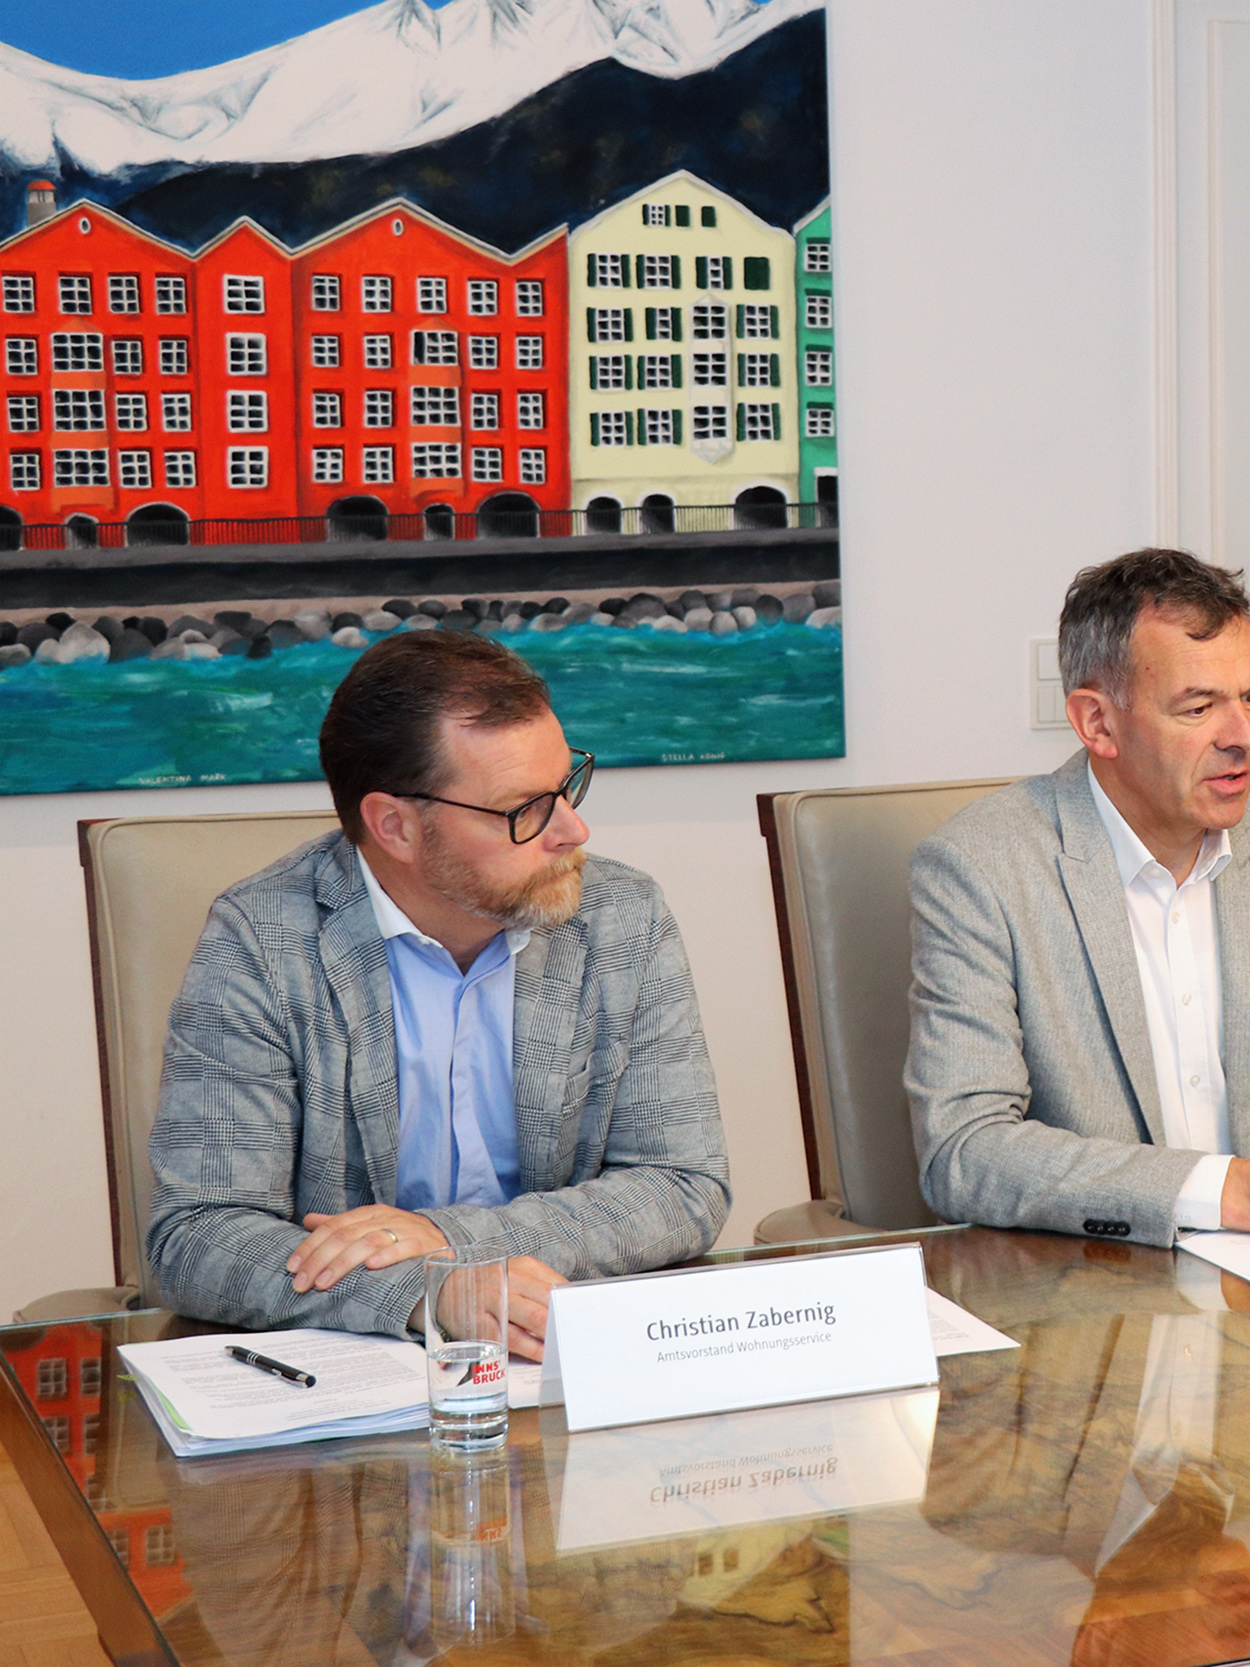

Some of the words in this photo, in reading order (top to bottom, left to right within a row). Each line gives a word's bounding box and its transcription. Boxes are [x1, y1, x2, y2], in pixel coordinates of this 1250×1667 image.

[139, 774, 192, 785] VALENTINA
[646, 1314, 740, 1341] Christian
[745, 1301, 837, 1329] Zabernig
[657, 1342, 735, 1363] Amtsvorstand
[736, 1331, 832, 1353] Wohnungsservice
[473, 1368, 506, 1385] BRUCK
